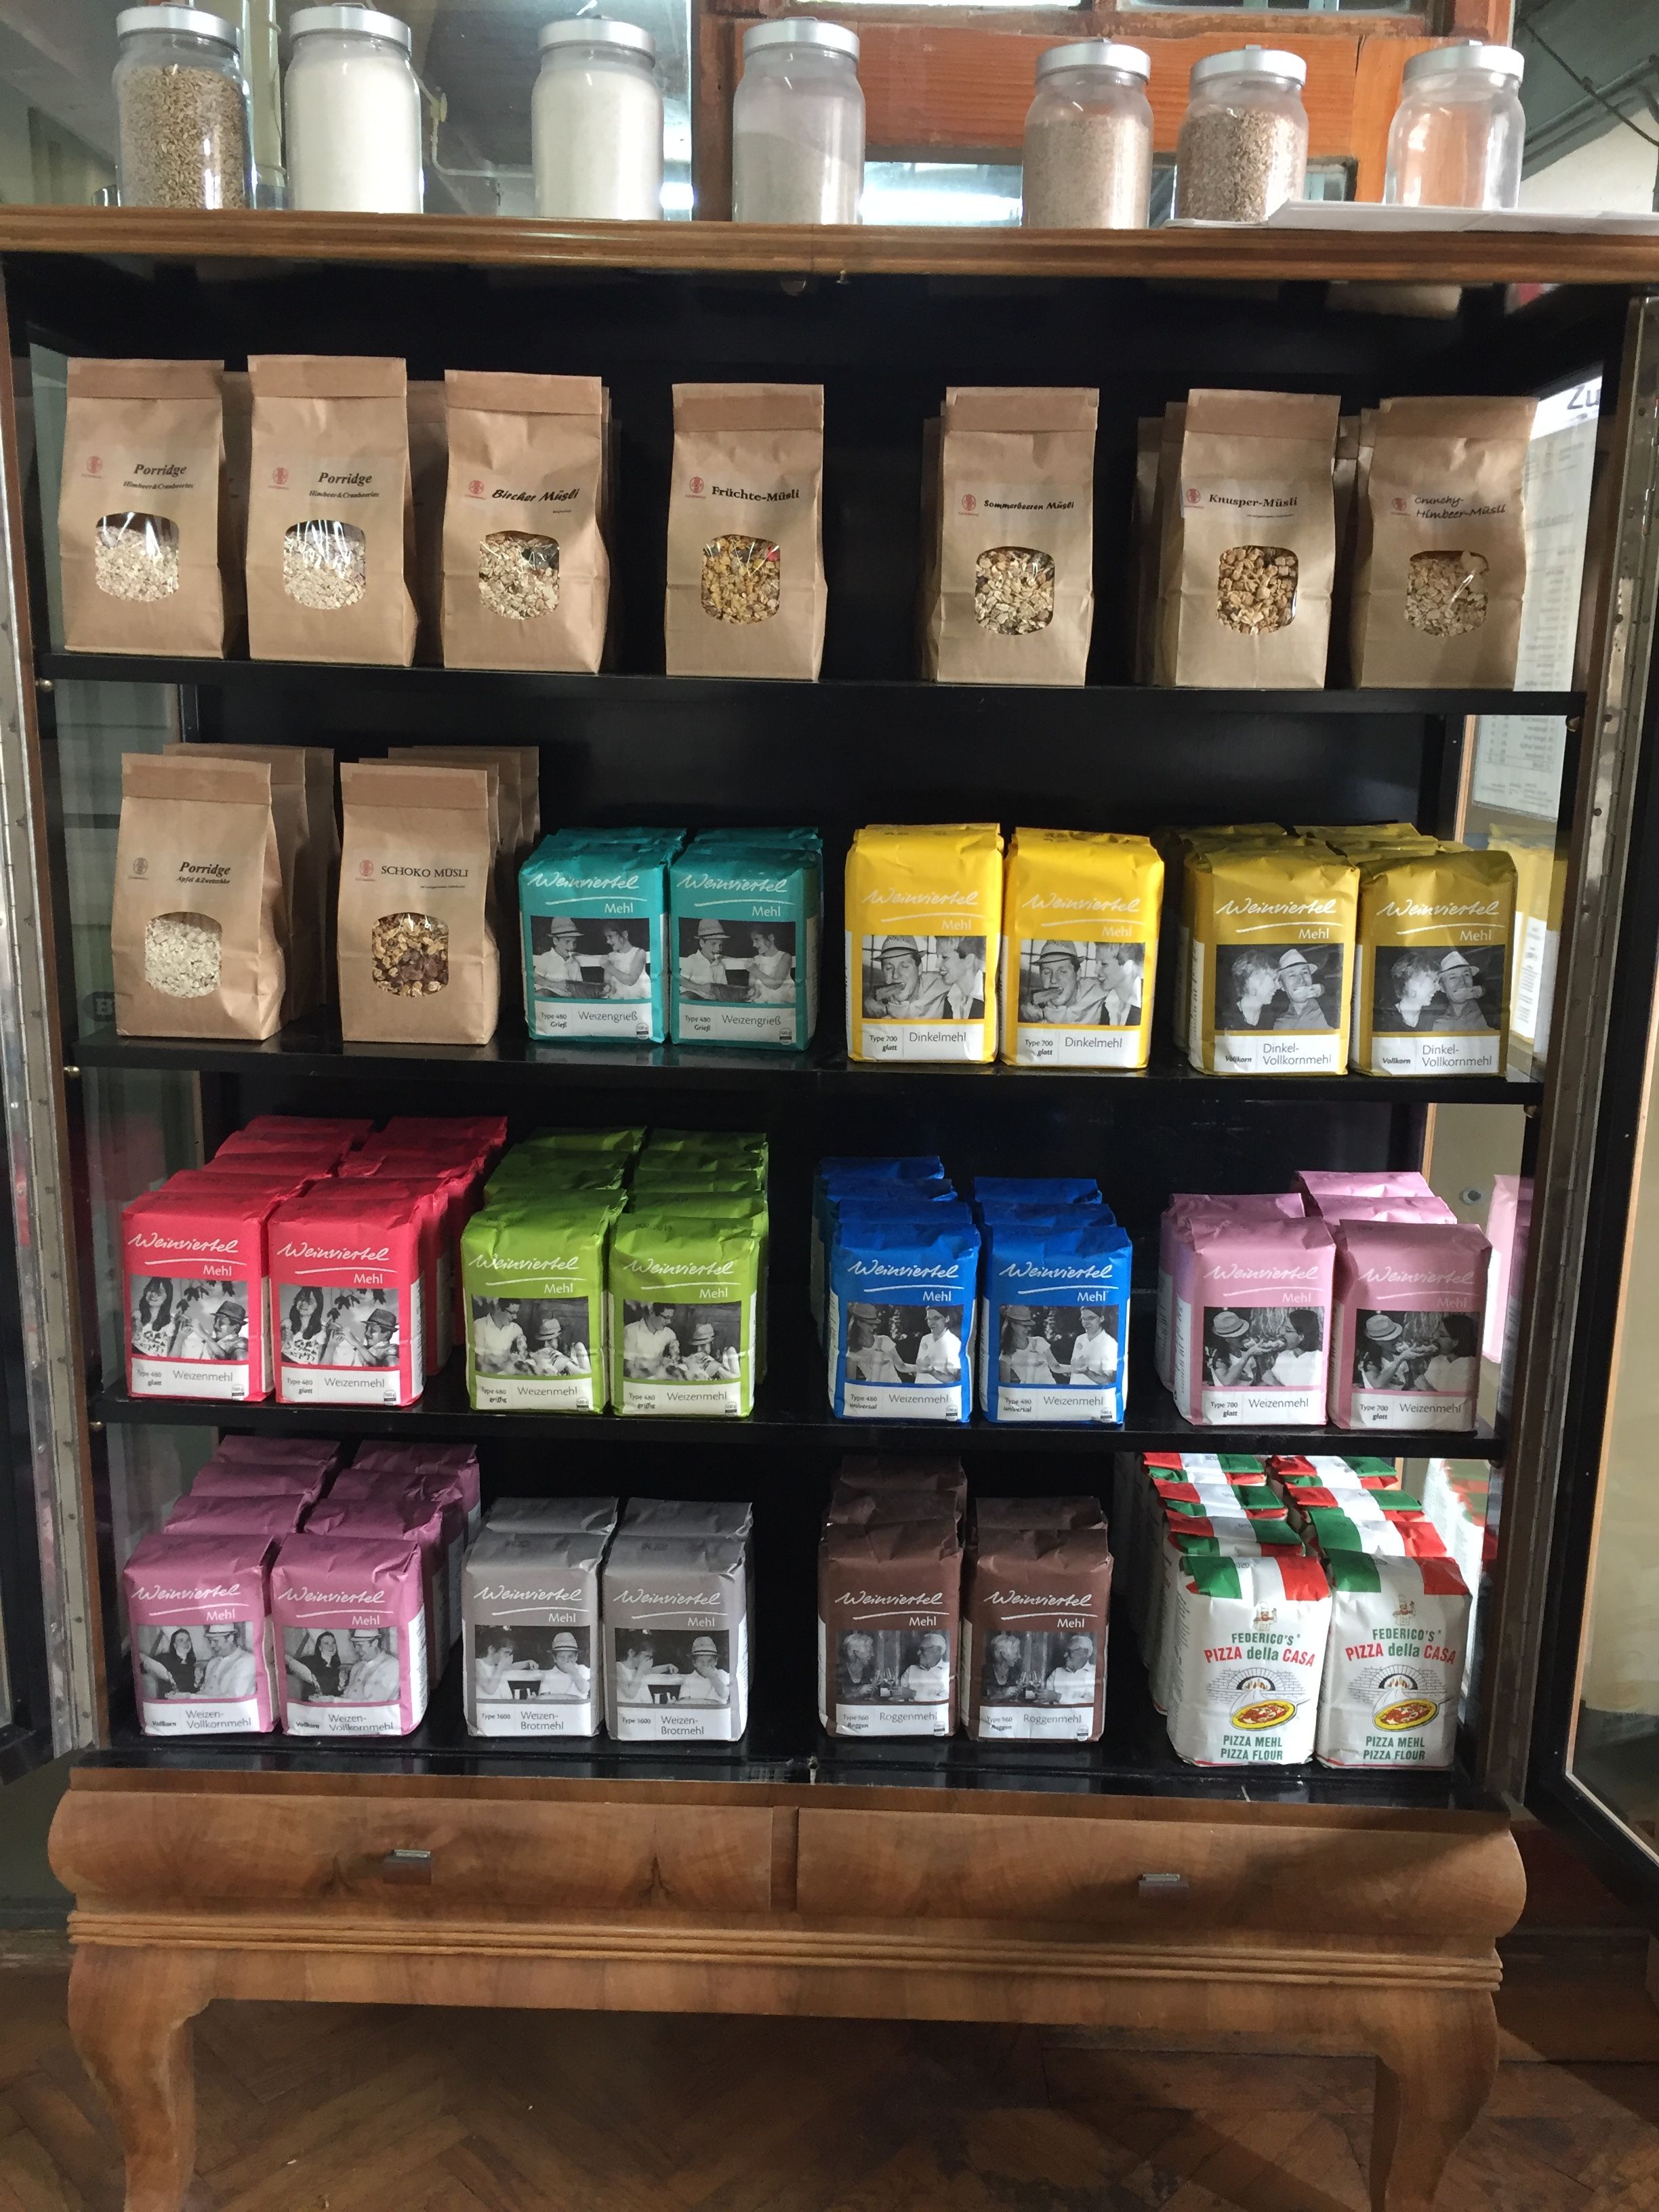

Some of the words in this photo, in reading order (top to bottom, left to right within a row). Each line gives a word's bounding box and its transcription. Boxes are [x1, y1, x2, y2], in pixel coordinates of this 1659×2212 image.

[134, 464, 187, 477] Porridge
[318, 472, 372, 487] Porridge
[492, 489, 536, 502] Bircher
[538, 489, 580, 501] Müsli
[712, 486, 800, 502] Früchte-Müsli
[984, 500, 1043, 510] Sommerbeeren
[1046, 501, 1074, 510] Müsli
[1209, 494, 1298, 508] Knusper-Müsli
[1414, 496, 1464, 507] Crunchy-
[1416, 504, 1505, 519] Himbeer-Müsli
[180, 862, 230, 877] Porridge
[382, 866, 430, 877] SCHOKO
[434, 869, 468, 877] MÜSLI
[528, 872, 639, 890] Weinviertel
[676, 874, 787, 893] Weinviertel
[861, 888, 980, 906] Weinviertel
[605, 903, 634, 914] Mehl
[1022, 894, 1140, 913] Weinviertel
[1215, 897, 1337, 916] Weinviertel
[1376, 899, 1500, 918] Weinviertel
[752, 905, 781, 917] Mehl
[941, 918, 972, 930] Mehl
[1102, 926, 1132, 937] Mehl
[1298, 928, 1330, 939] Mehl
[1460, 930, 1492, 941] Mehl
[578, 1011, 638, 1023] Weizengrieß
[722, 1015, 781, 1027] Weizengrieß
[909, 1031, 966, 1043] Dinkelmehl
[1065, 1037, 1123, 1049] Dinkelmehl
[882, 1044, 898, 1052] glatt
[1263, 1043, 1299, 1054] Dinkel-
[1422, 1046, 1459, 1054] Dinkel-
[1263, 1054, 1332, 1066] Vollkornmehl
[1422, 1056, 1492, 1067] Vollkornmehl
[128, 1233, 239, 1253] Weinviertel
[276, 1242, 390, 1262] Weinviertel
[468, 1254, 579, 1271] Weinviertel
[623, 1258, 735, 1275] Weinviertel
[203, 1265, 232, 1276] Mehl
[847, 1260, 960, 1279] Weinviertel
[998, 1261, 1113, 1279] Weinviertel
[1203, 1263, 1319, 1281] Weinviertel
[354, 1274, 383, 1284] Mehl
[1358, 1267, 1475, 1285] Weinviertel
[544, 1284, 573, 1294] Mehl
[699, 1288, 728, 1298] Mehl
[922, 1290, 951, 1302] Mehl
[1078, 1290, 1106, 1302] Mehl
[1282, 1292, 1311, 1303] Mehl
[1437, 1297, 1468, 1309] Mehl
[173, 1370, 232, 1381] Weizenmehl
[325, 1378, 384, 1388] Weizenmehl
[517, 1387, 577, 1395] Weizenmehl
[667, 1391, 726, 1401] Weizenmehl
[889, 1394, 949, 1404] Weizenmehl
[1044, 1396, 1103, 1405] Weizenmehl
[1248, 1397, 1309, 1408] Weizenmehl
[1223, 1409, 1238, 1417] glatt
[1399, 1402, 1461, 1414] Weizenmehl
[131, 1584, 241, 1600] Weinviertel
[278, 1586, 386, 1603] Weinviertel
[474, 1585, 582, 1602] Weinviertel
[613, 1589, 722, 1605] Weinviertel
[835, 1591, 943, 1605] Weinviertel
[983, 1591, 1092, 1607] Weinviertel
[206, 1611, 236, 1622] Mehl
[352, 1615, 380, 1625] Mehl
[548, 1613, 576, 1623] Mehl
[688, 1617, 715, 1627] Mehl
[909, 1616, 937, 1626] Mehl
[1057, 1618, 1085, 1628] Mehl
[1231, 1633, 1294, 1645] FEDERICO'S
[1372, 1629, 1435, 1641] FEDERICO'S
[1204, 1647, 1243, 1663] PIZZA
[1246, 1645, 1278, 1660] della
[1282, 1648, 1315, 1667] CASA
[1345, 1643, 1385, 1661] PIZZA
[1388, 1642, 1420, 1657] della
[1423, 1645, 1456, 1664] CASA
[185, 1710, 224, 1719] Weizen-
[328, 1714, 367, 1723] Weizen-
[520, 1711, 558, 1721] Weizen-
[661, 1715, 699, 1725] Weizen-
[880, 1712, 937, 1723] Roggenmehl
[1024, 1714, 1081, 1725] Roggenmehl
[186, 1718, 251, 1729] Vollkornmehl
[329, 1722, 393, 1732] Vollkornmehl
[520, 1721, 564, 1730] Brotmehl
[661, 1726, 704, 1735] Brotmehl
[1223, 1735, 1252, 1747] PIZZA
[1255, 1737, 1283, 1747] MEHL
[1366, 1736, 1395, 1747] PIZZA
[1398, 1736, 1425, 1747] MEHL
[1221, 1748, 1250, 1760] PIZZA
[1253, 1749, 1283, 1761] FLOUR
[1363, 1750, 1393, 1761] PIZZA
[1395, 1750, 1425, 1761] FLOUR
